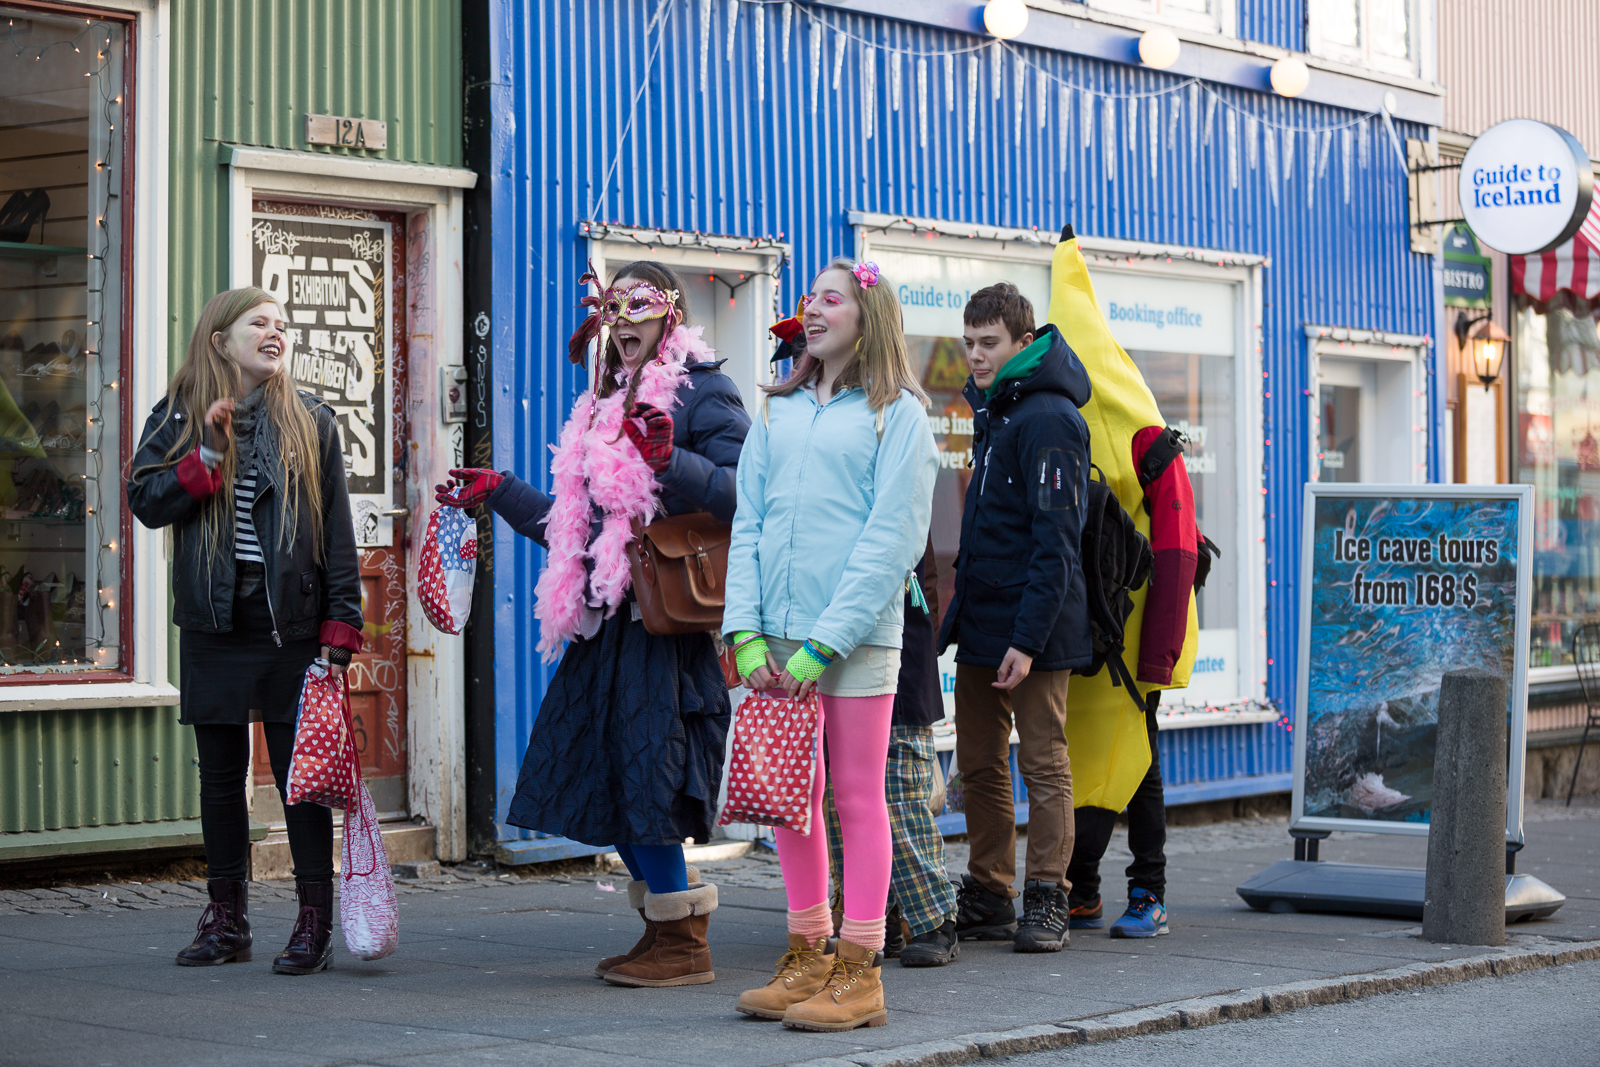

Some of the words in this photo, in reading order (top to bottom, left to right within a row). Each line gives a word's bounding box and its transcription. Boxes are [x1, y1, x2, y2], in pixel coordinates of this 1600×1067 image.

[336, 119, 366, 147] 12A
[1473, 164, 1532, 187] Guide
[1538, 163, 1561, 182] to
[1473, 183, 1562, 208] Iceland
[292, 275, 346, 307] EXHIBITION
[1444, 268, 1485, 291] BISTRO
[899, 285, 943, 308] Guide
[947, 290, 962, 309] to
[1109, 302, 1165, 329] Booking
[1166, 306, 1203, 327] office
[293, 352, 346, 390] NOVEMBER
[1333, 530, 1371, 562] Ice
[1378, 537, 1432, 564] cave
[1438, 533, 1499, 564] tours
[1353, 574, 1407, 606] from
[1415, 574, 1457, 607] 168
[1463, 573, 1477, 610] $
